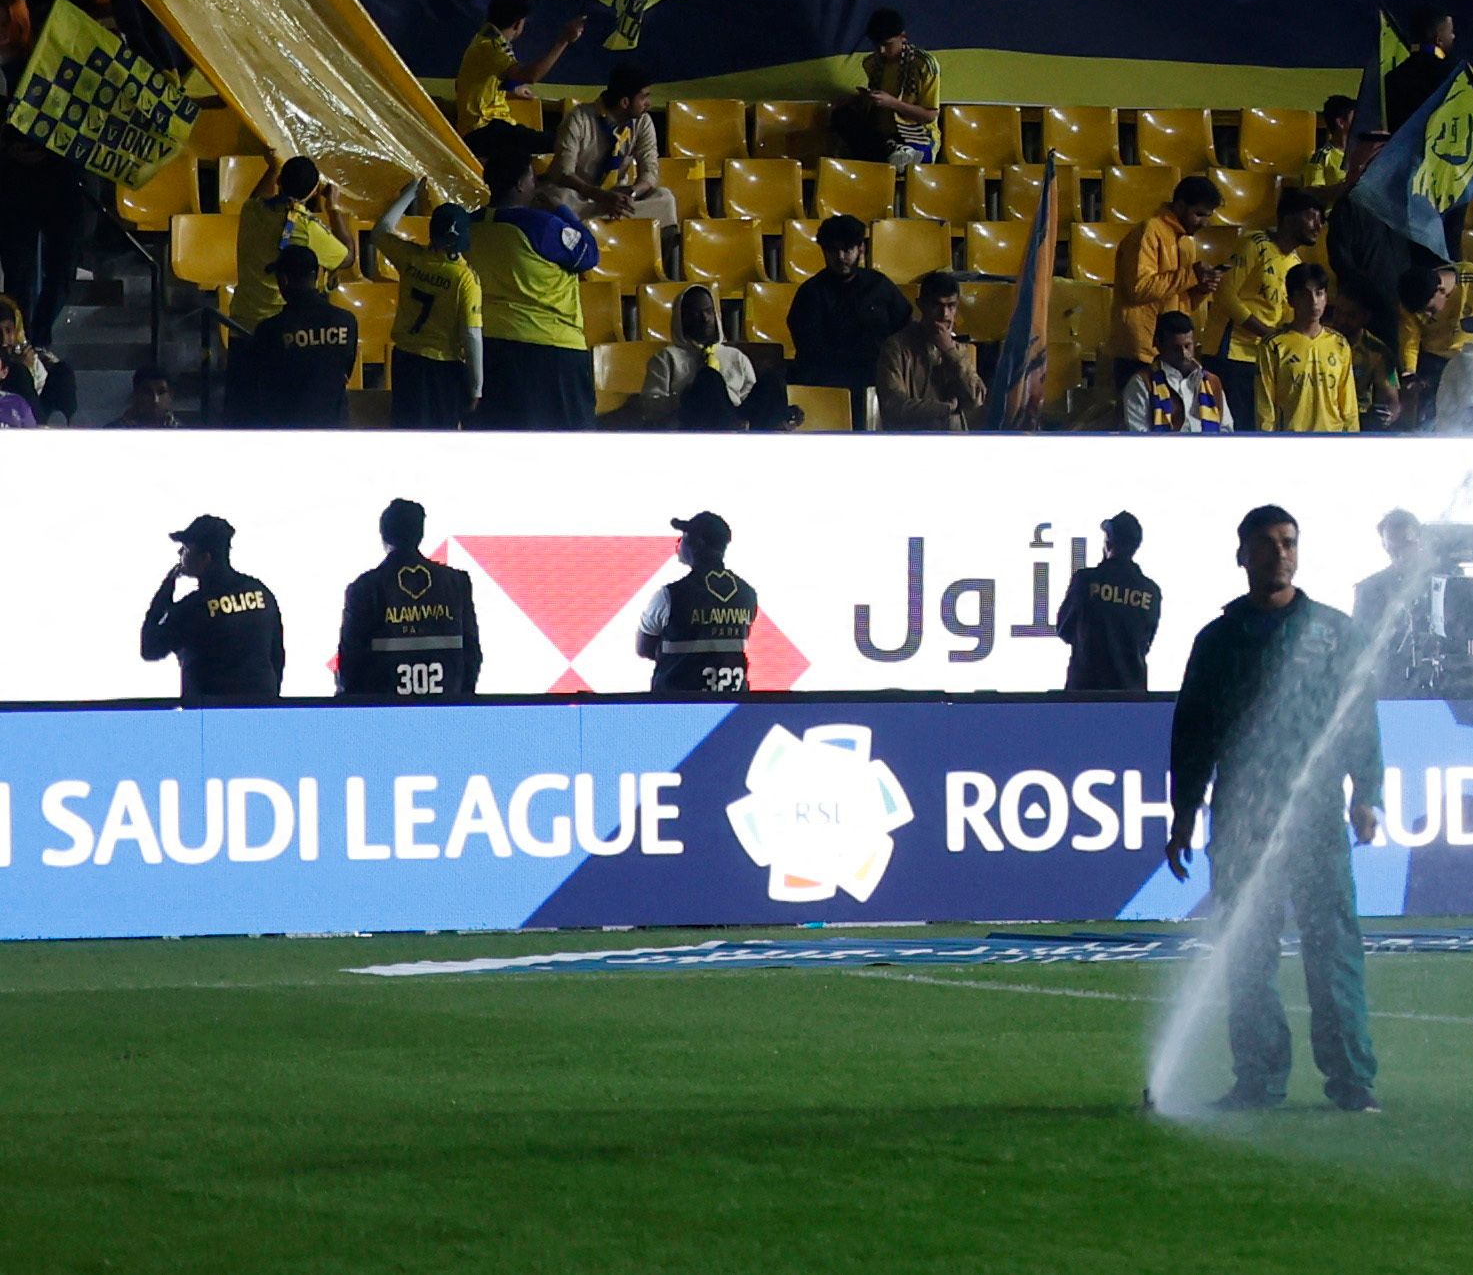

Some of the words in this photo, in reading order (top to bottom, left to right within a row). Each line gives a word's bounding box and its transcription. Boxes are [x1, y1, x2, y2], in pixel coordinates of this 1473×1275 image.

[120, 130, 172, 164] ONLY
[90, 148, 140, 182] LOVE
[410, 287, 435, 334] 7
[283, 326, 348, 349] POLICE
[208, 591, 266, 617] POLICE
[1090, 582, 1153, 610] POLICE
[386, 605, 454, 624] ALAWWAL
[397, 662, 444, 695] 302
[42, 775, 320, 867] SAUDI
[345, 771, 685, 862] LEAGUE
[946, 769, 1174, 853] ROSH
